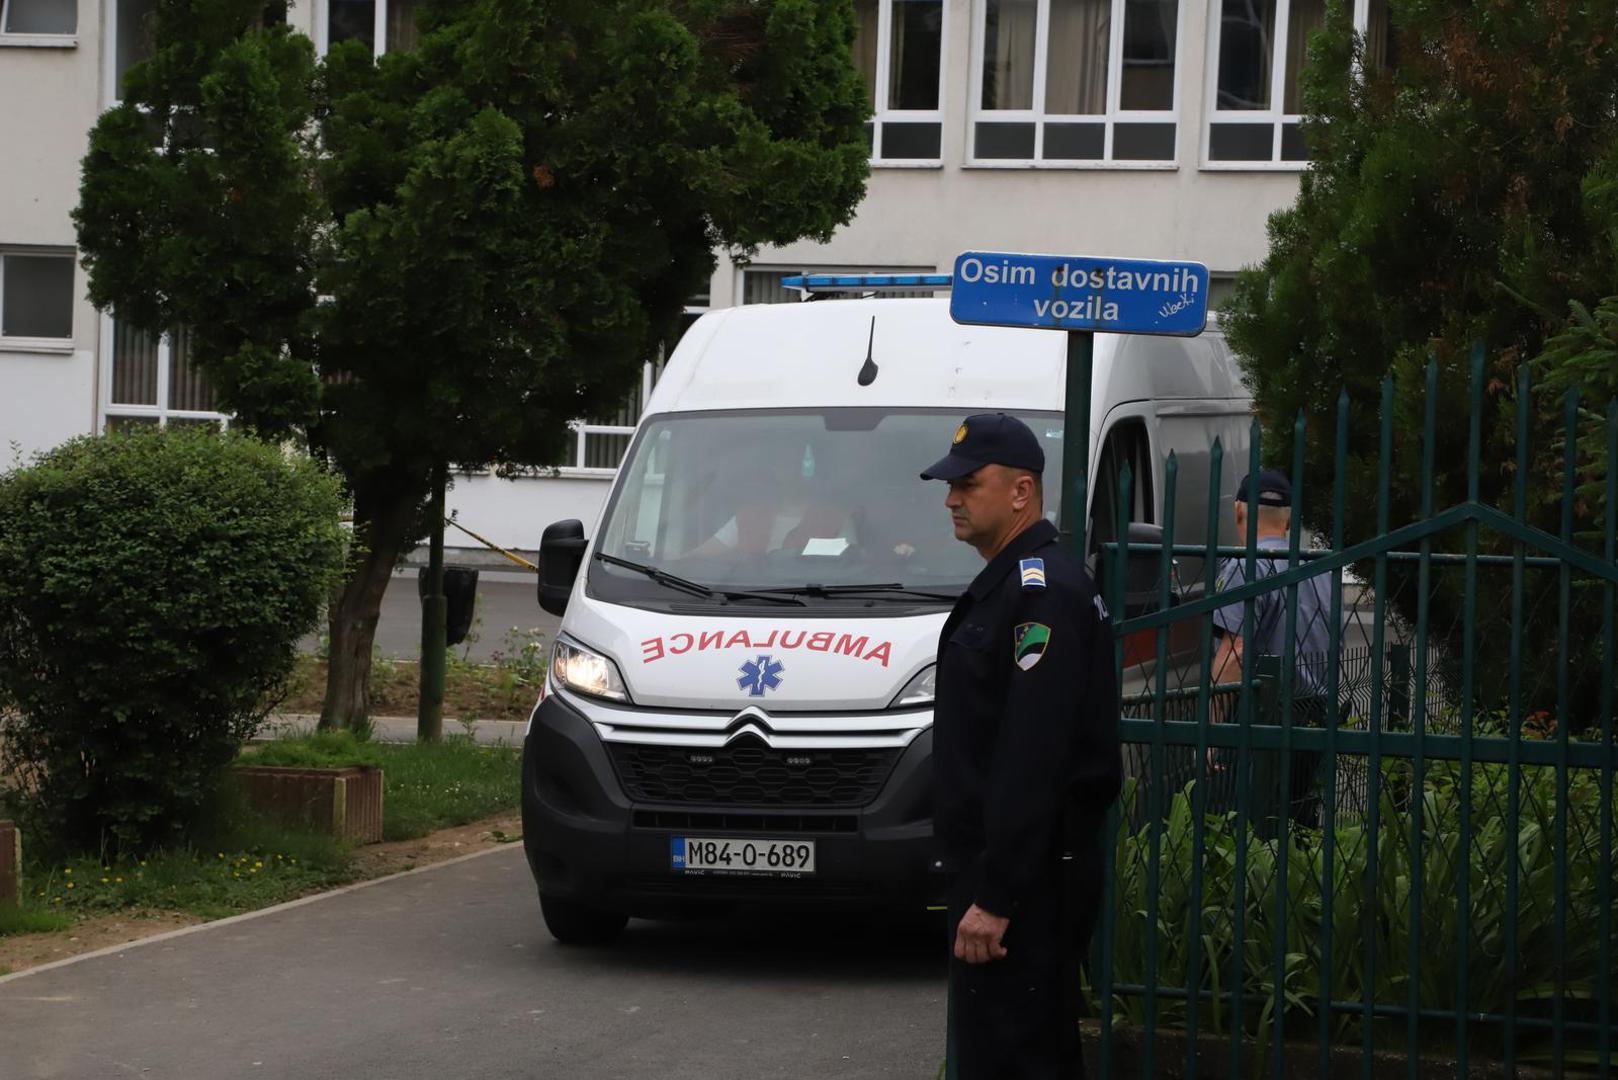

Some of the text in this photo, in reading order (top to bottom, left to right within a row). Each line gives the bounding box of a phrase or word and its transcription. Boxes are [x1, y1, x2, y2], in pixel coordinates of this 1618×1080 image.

[960, 258, 1199, 293] Osim dostavnih
[1033, 296, 1119, 320] vozila
